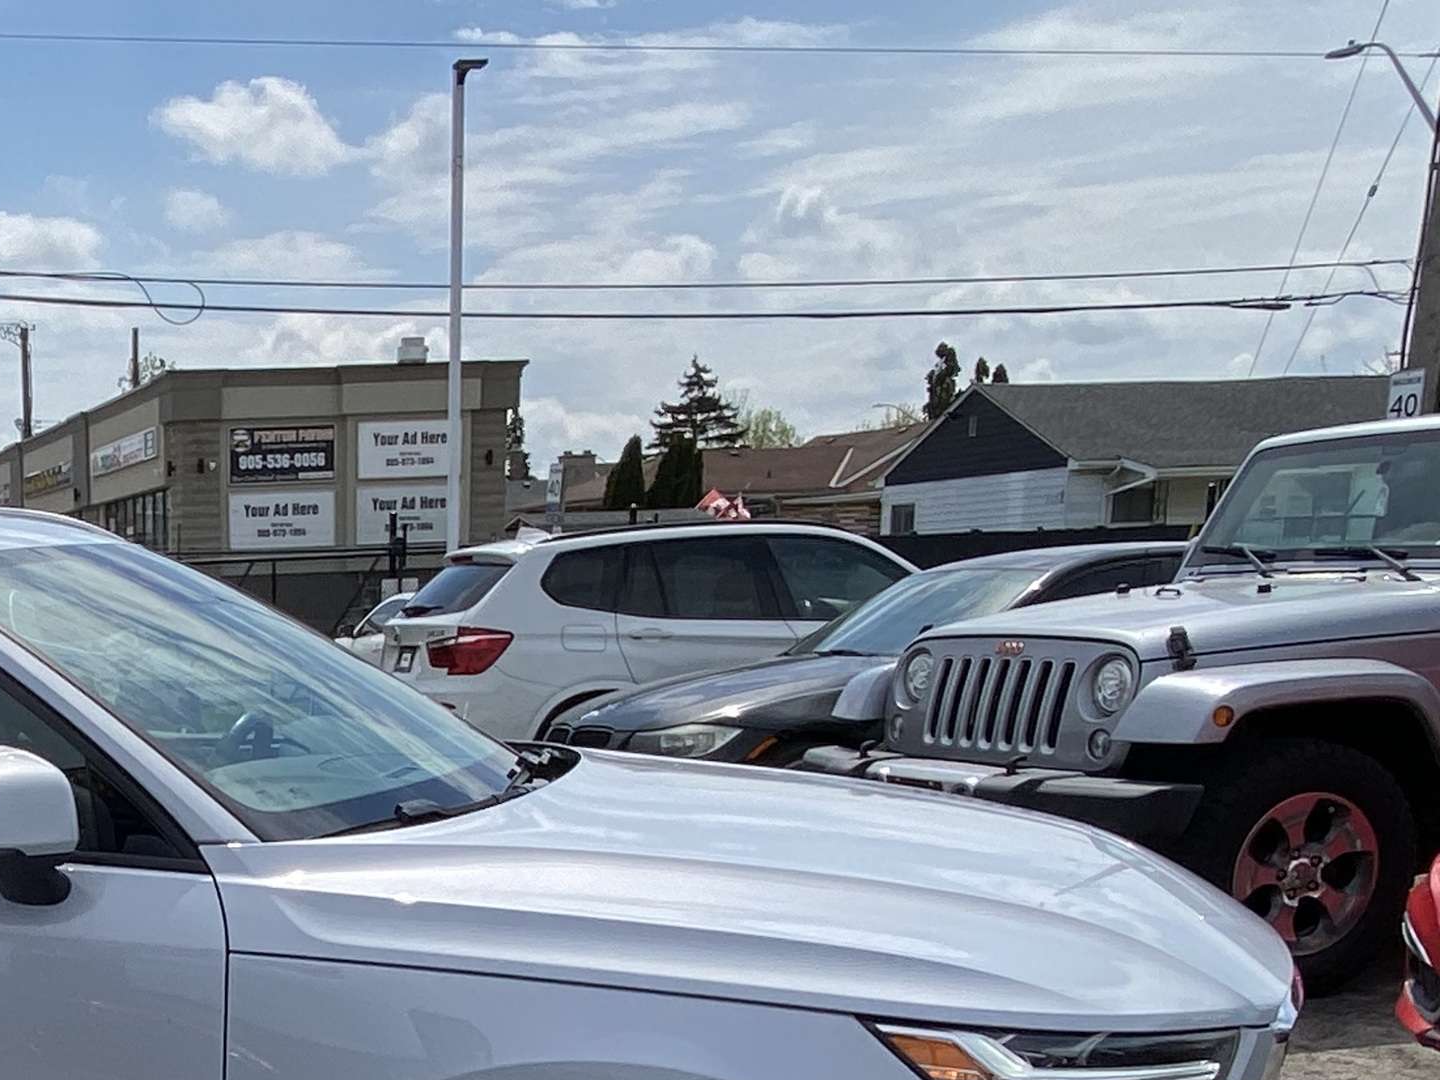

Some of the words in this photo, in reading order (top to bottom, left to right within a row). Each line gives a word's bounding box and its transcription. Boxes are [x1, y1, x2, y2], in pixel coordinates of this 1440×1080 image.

[1389, 393, 1418, 417] 40
[372, 432, 400, 447] Your
[401, 431, 418, 446] Ad
[420, 430, 448, 445] Here
[243, 503, 271, 518] Your
[273, 502, 289, 517] Ad
[291, 502, 320, 516] Here
[371, 497, 398, 512] Your
[400, 496, 416, 510] Ad
[419, 495, 447, 510] Here
